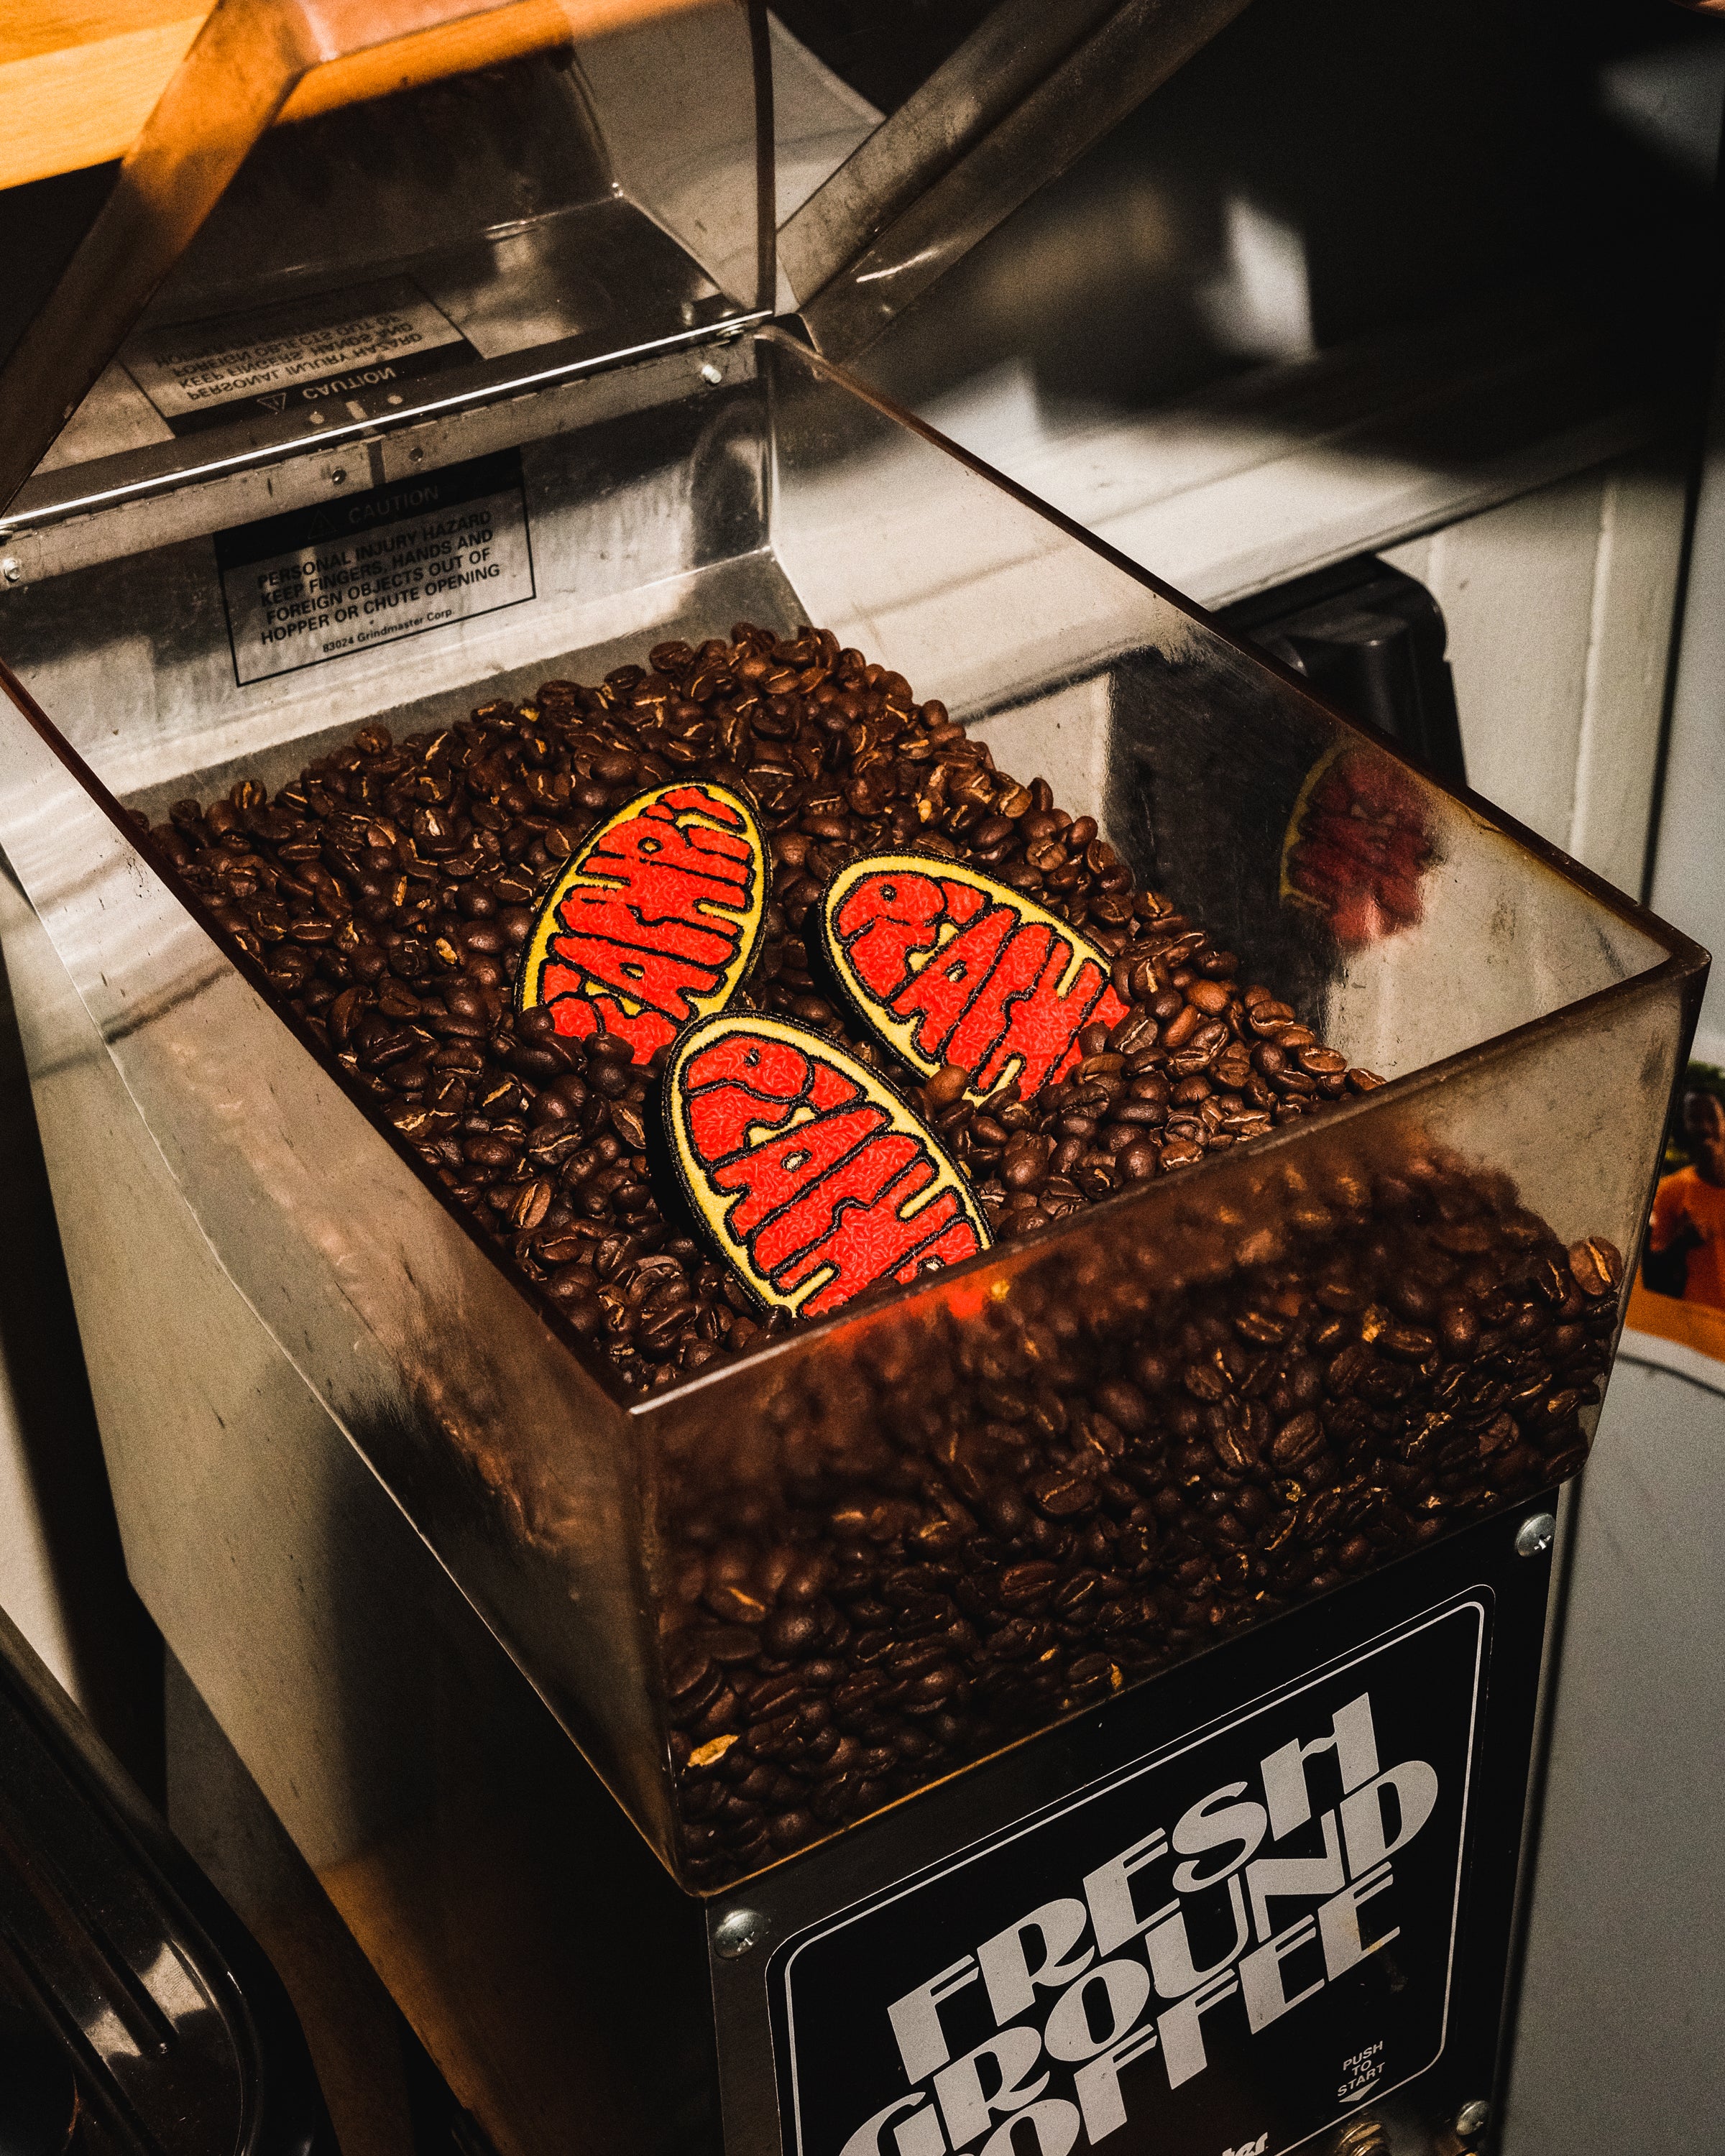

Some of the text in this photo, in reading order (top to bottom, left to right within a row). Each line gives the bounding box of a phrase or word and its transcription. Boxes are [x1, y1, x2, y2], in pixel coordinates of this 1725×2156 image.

[349, 485, 439, 524] CAUTION
[257, 510, 492, 589] PERSONAL INJURY HAZARD
[260, 583, 303, 607] KEEP
[392, 540, 452, 568] HANDS
[458, 529, 494, 550] AND
[267, 548, 491, 625] FOREIGN OBJECTS OUT OF
[261, 563, 500, 645] HOPPER OR CHUTE OPENING
[357, 616, 424, 642] Grindmaster
[888, 1692, 1379, 2084] FRESH
[950, 1861, 1400, 2156] OFFEE
[1337, 2062, 1385, 2097] START
[1343, 2040, 1383, 2070] PUSH
[1352, 2059, 1371, 2076] TO
